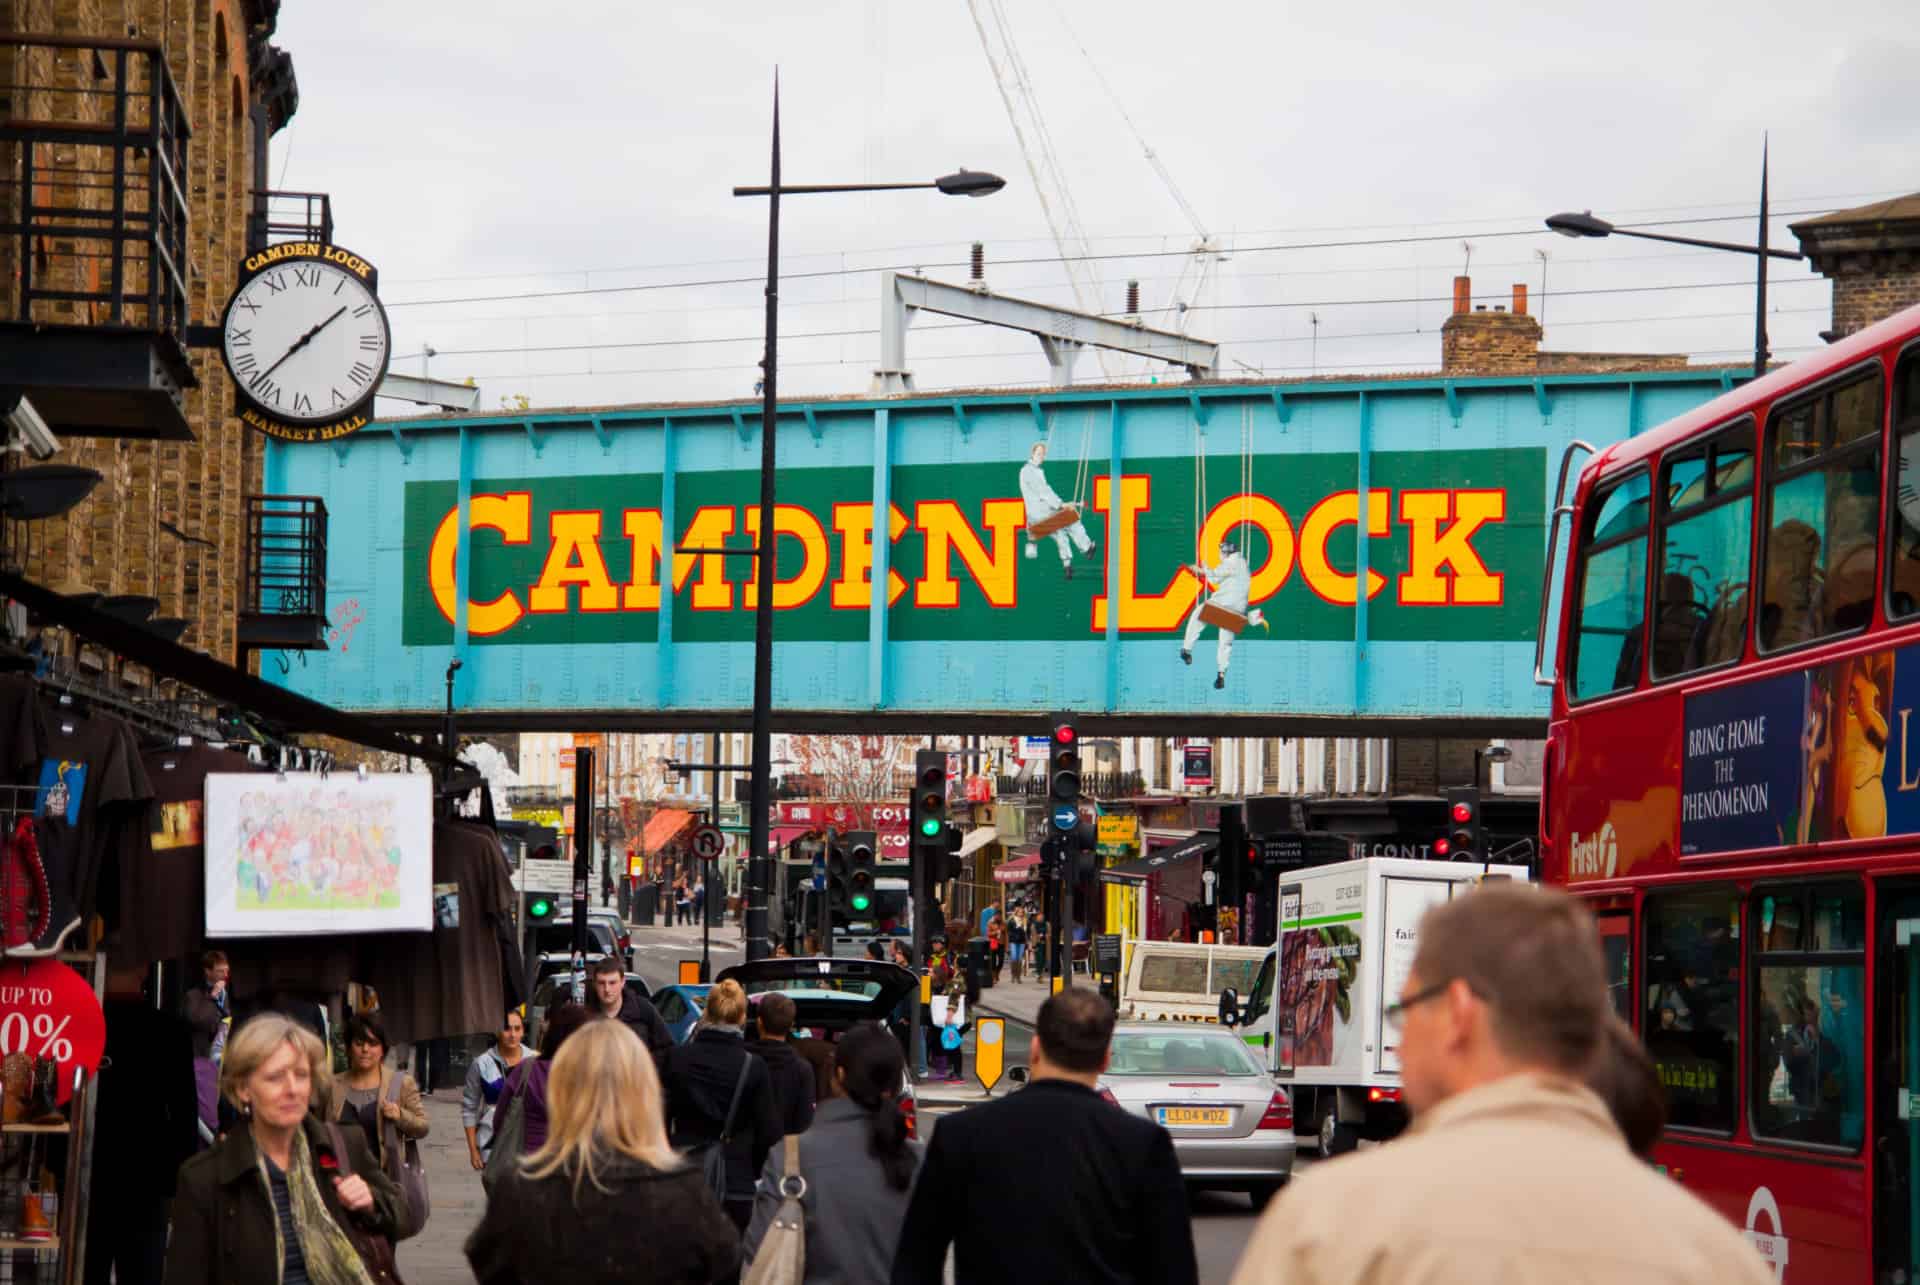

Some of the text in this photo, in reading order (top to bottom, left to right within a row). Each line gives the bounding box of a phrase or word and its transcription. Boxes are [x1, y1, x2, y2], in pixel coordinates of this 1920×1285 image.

[246, 243, 371, 278] CAMDEN LOCK
[264, 273, 287, 295] XI
[295, 269, 320, 287] XII
[240, 296, 262, 315] X
[352, 304, 371, 318] II
[232, 328, 252, 346] IX
[360, 336, 378, 350] III
[348, 362, 372, 386] IIII
[294, 392, 312, 410] VI
[332, 388, 346, 406] V
[242, 409, 366, 441] MARKET HALL
[429, 474, 1506, 637] CAMDEN LOCK
[1689, 715, 1766, 758] BRING HOME
[1714, 758, 1735, 784] THE
[1682, 781, 1768, 823] PHENOMENON
[1571, 831, 1598, 876] First
[1, 986, 52, 1006] UP TO
